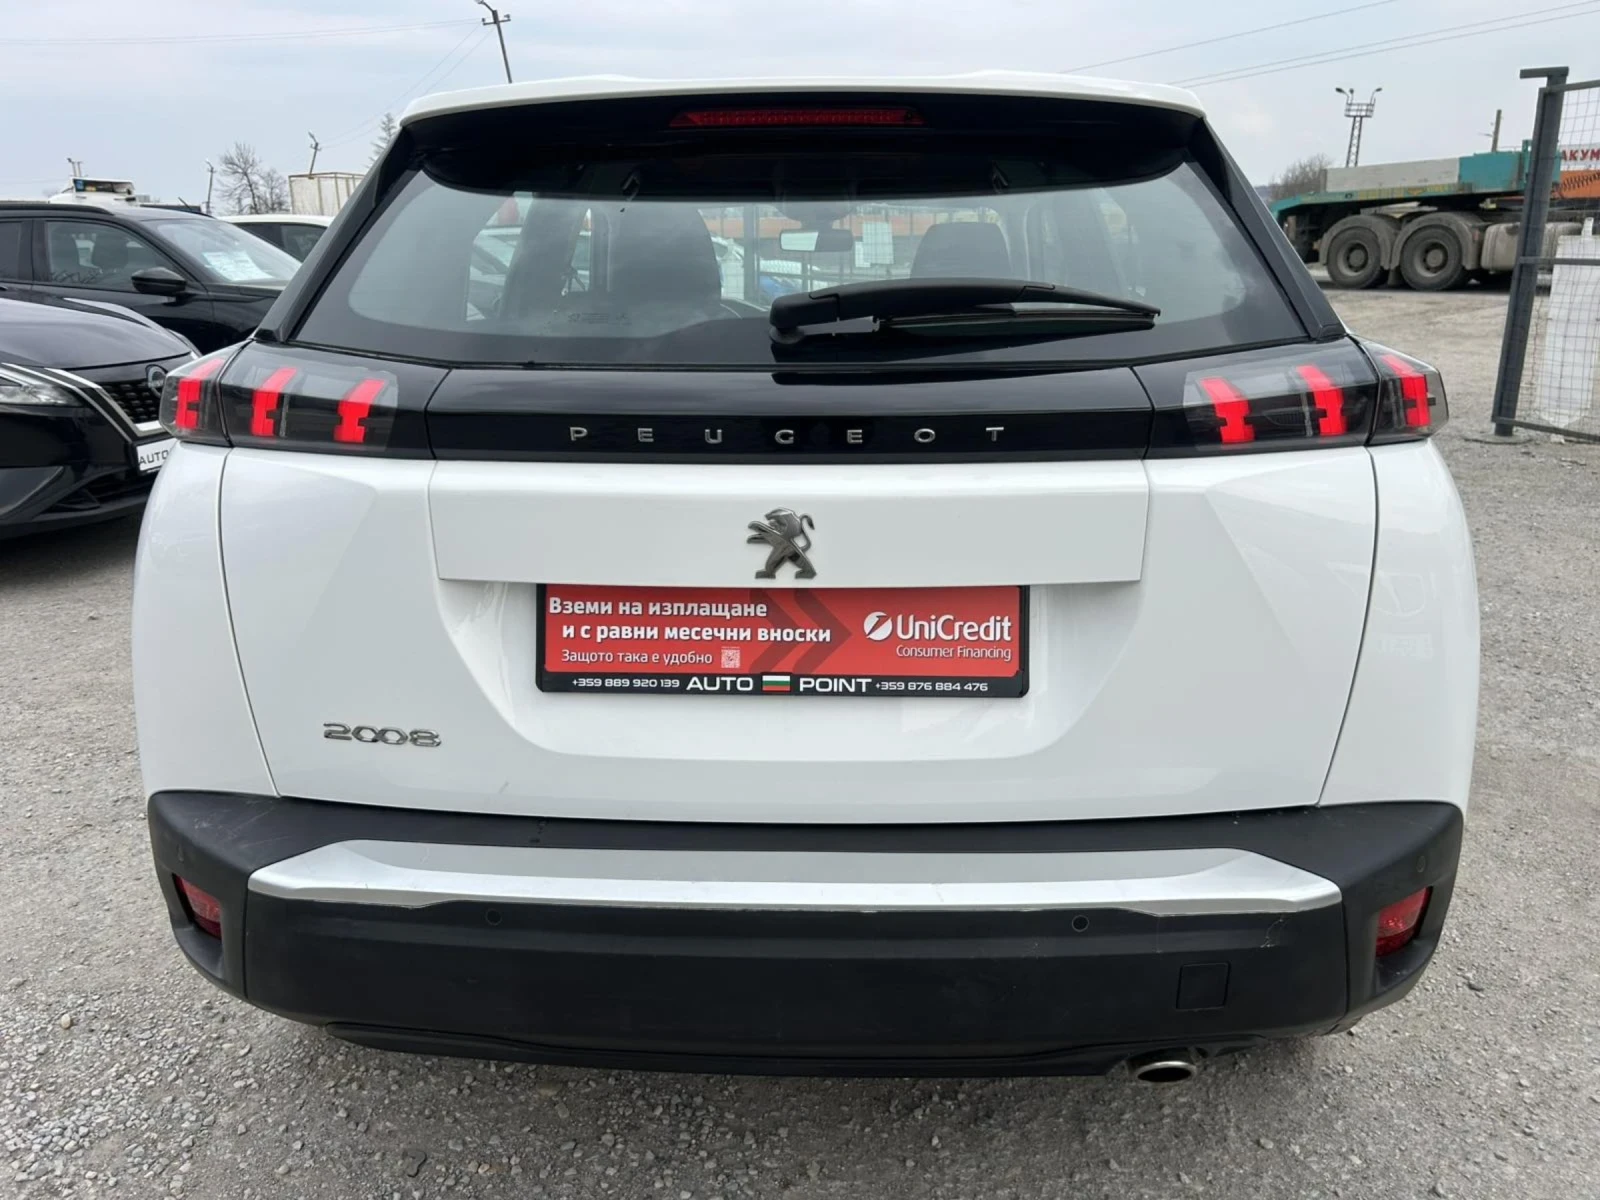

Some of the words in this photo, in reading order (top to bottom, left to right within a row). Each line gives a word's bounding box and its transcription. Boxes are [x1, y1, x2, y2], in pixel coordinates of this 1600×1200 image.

[570, 426, 1005, 445] PEUGEOT
[139, 450, 168, 464] AUTO
[549, 597, 613, 615] Вземи
[618, 602, 642, 615] на
[648, 602, 768, 620] изплащане
[562, 625, 575, 638] и
[580, 625, 591, 638] с
[596, 625, 659, 642] равни
[664, 627, 751, 641] месечни
[757, 629, 831, 642] вноски
[897, 614, 1012, 641] UniCredit
[561, 650, 613, 664] Защото
[617, 651, 648, 663] така
[651, 654, 660, 663] е
[663, 651, 713, 665] удобно
[896, 645, 954, 658] Consumer
[957, 646, 1012, 662] Financing
[572, 679, 602, 687] +359
[604, 679, 630, 688] 889
[632, 679, 658, 688] 920
[660, 679, 680, 688] 139
[686, 677, 754, 691] AUTO
[799, 678, 872, 693] POINT
[875, 682, 905, 691] +359
[907, 682, 933, 691] 876
[935, 682, 962, 691] 884
[963, 683, 989, 692] 476
[323, 722, 442, 747] 2008
